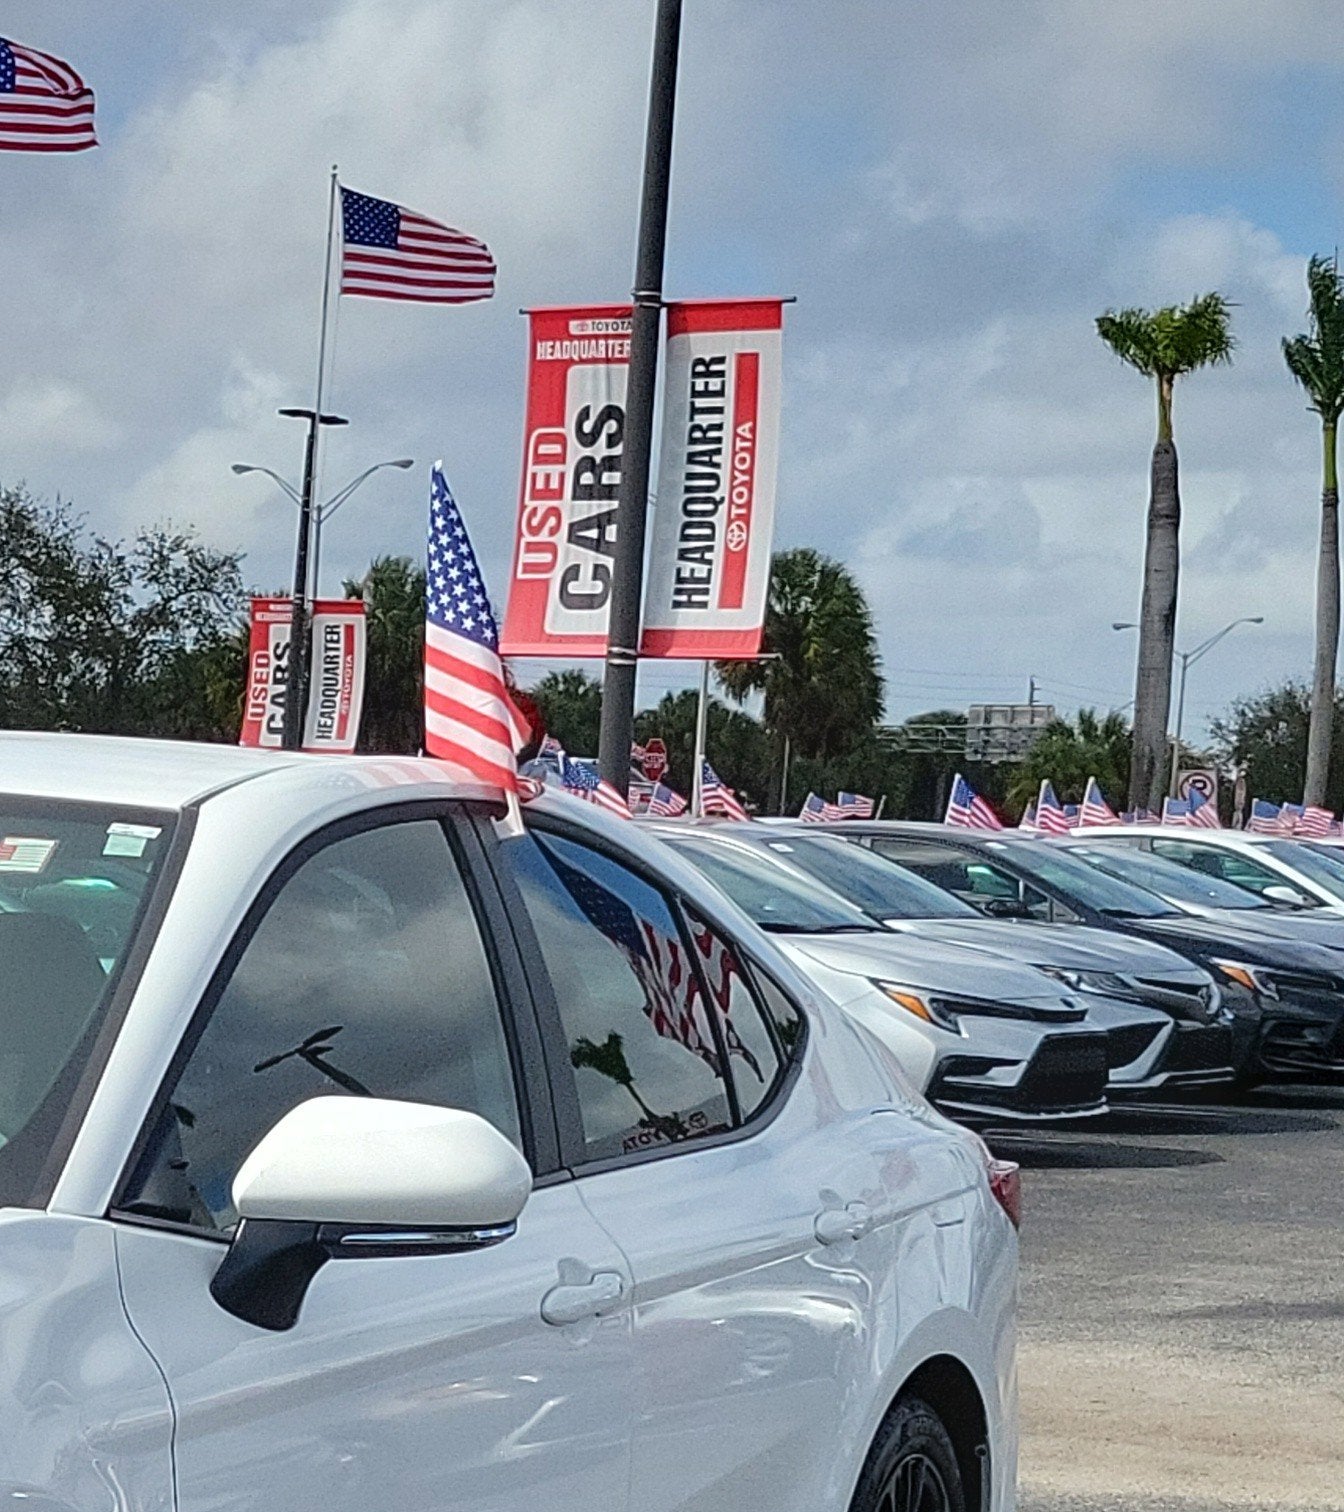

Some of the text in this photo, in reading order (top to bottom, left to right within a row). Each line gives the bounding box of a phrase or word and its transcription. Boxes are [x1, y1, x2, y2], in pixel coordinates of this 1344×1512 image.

[517, 427, 568, 580] USED
[559, 404, 626, 611] CARS
[670, 354, 727, 611] HEADQUARTER
[730, 420, 754, 519] TOYOTA
[248, 651, 271, 721] USED
[315, 624, 341, 740] HEADQUARTER
